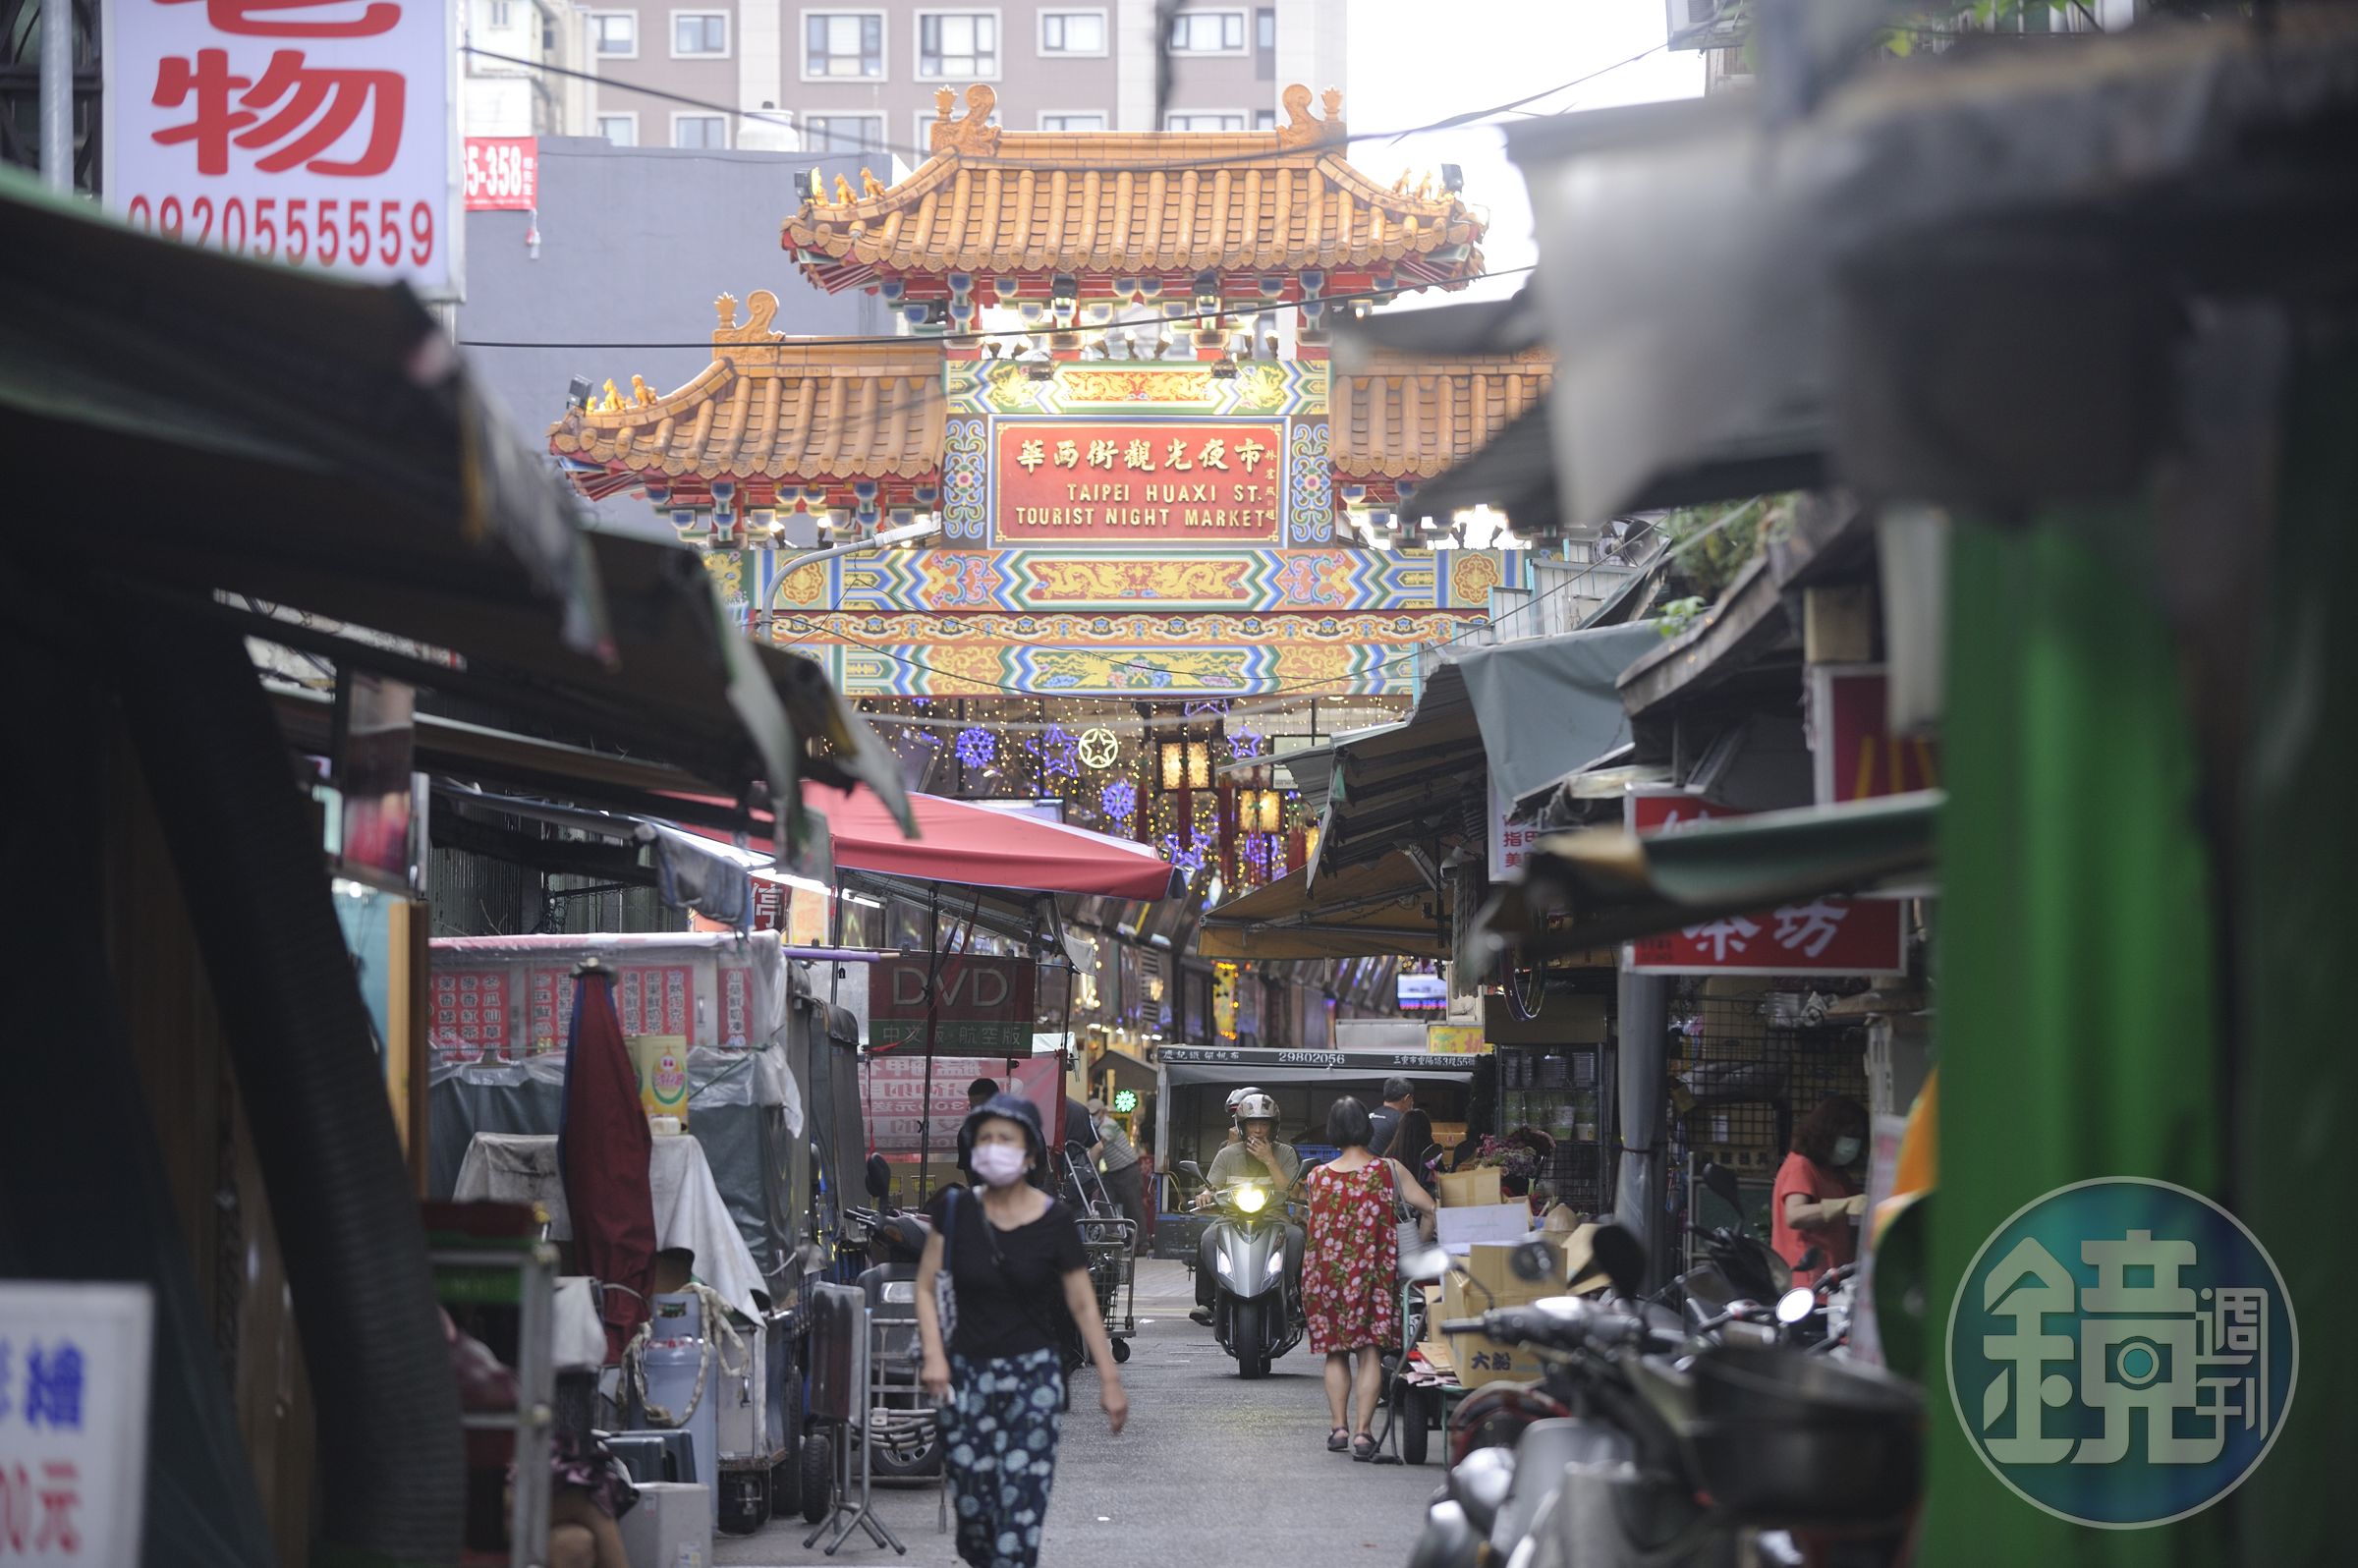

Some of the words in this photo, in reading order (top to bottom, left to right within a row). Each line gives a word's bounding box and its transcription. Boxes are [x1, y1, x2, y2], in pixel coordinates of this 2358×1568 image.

[464, 145, 522, 196] 5-358
[1016, 438, 1266, 474] 華西街觀光夜市
[1067, 482, 1131, 503] TAIPEI
[1146, 484, 1217, 504] HUAXI
[1233, 484, 1263, 504] ST.
[1015, 506, 1095, 527] TOURIST
[1105, 507, 1170, 528] NIGHT
[1184, 509, 1266, 529] MARKET
[892, 967, 1009, 1007] DVD
[1278, 1052, 1345, 1065] 29802056
